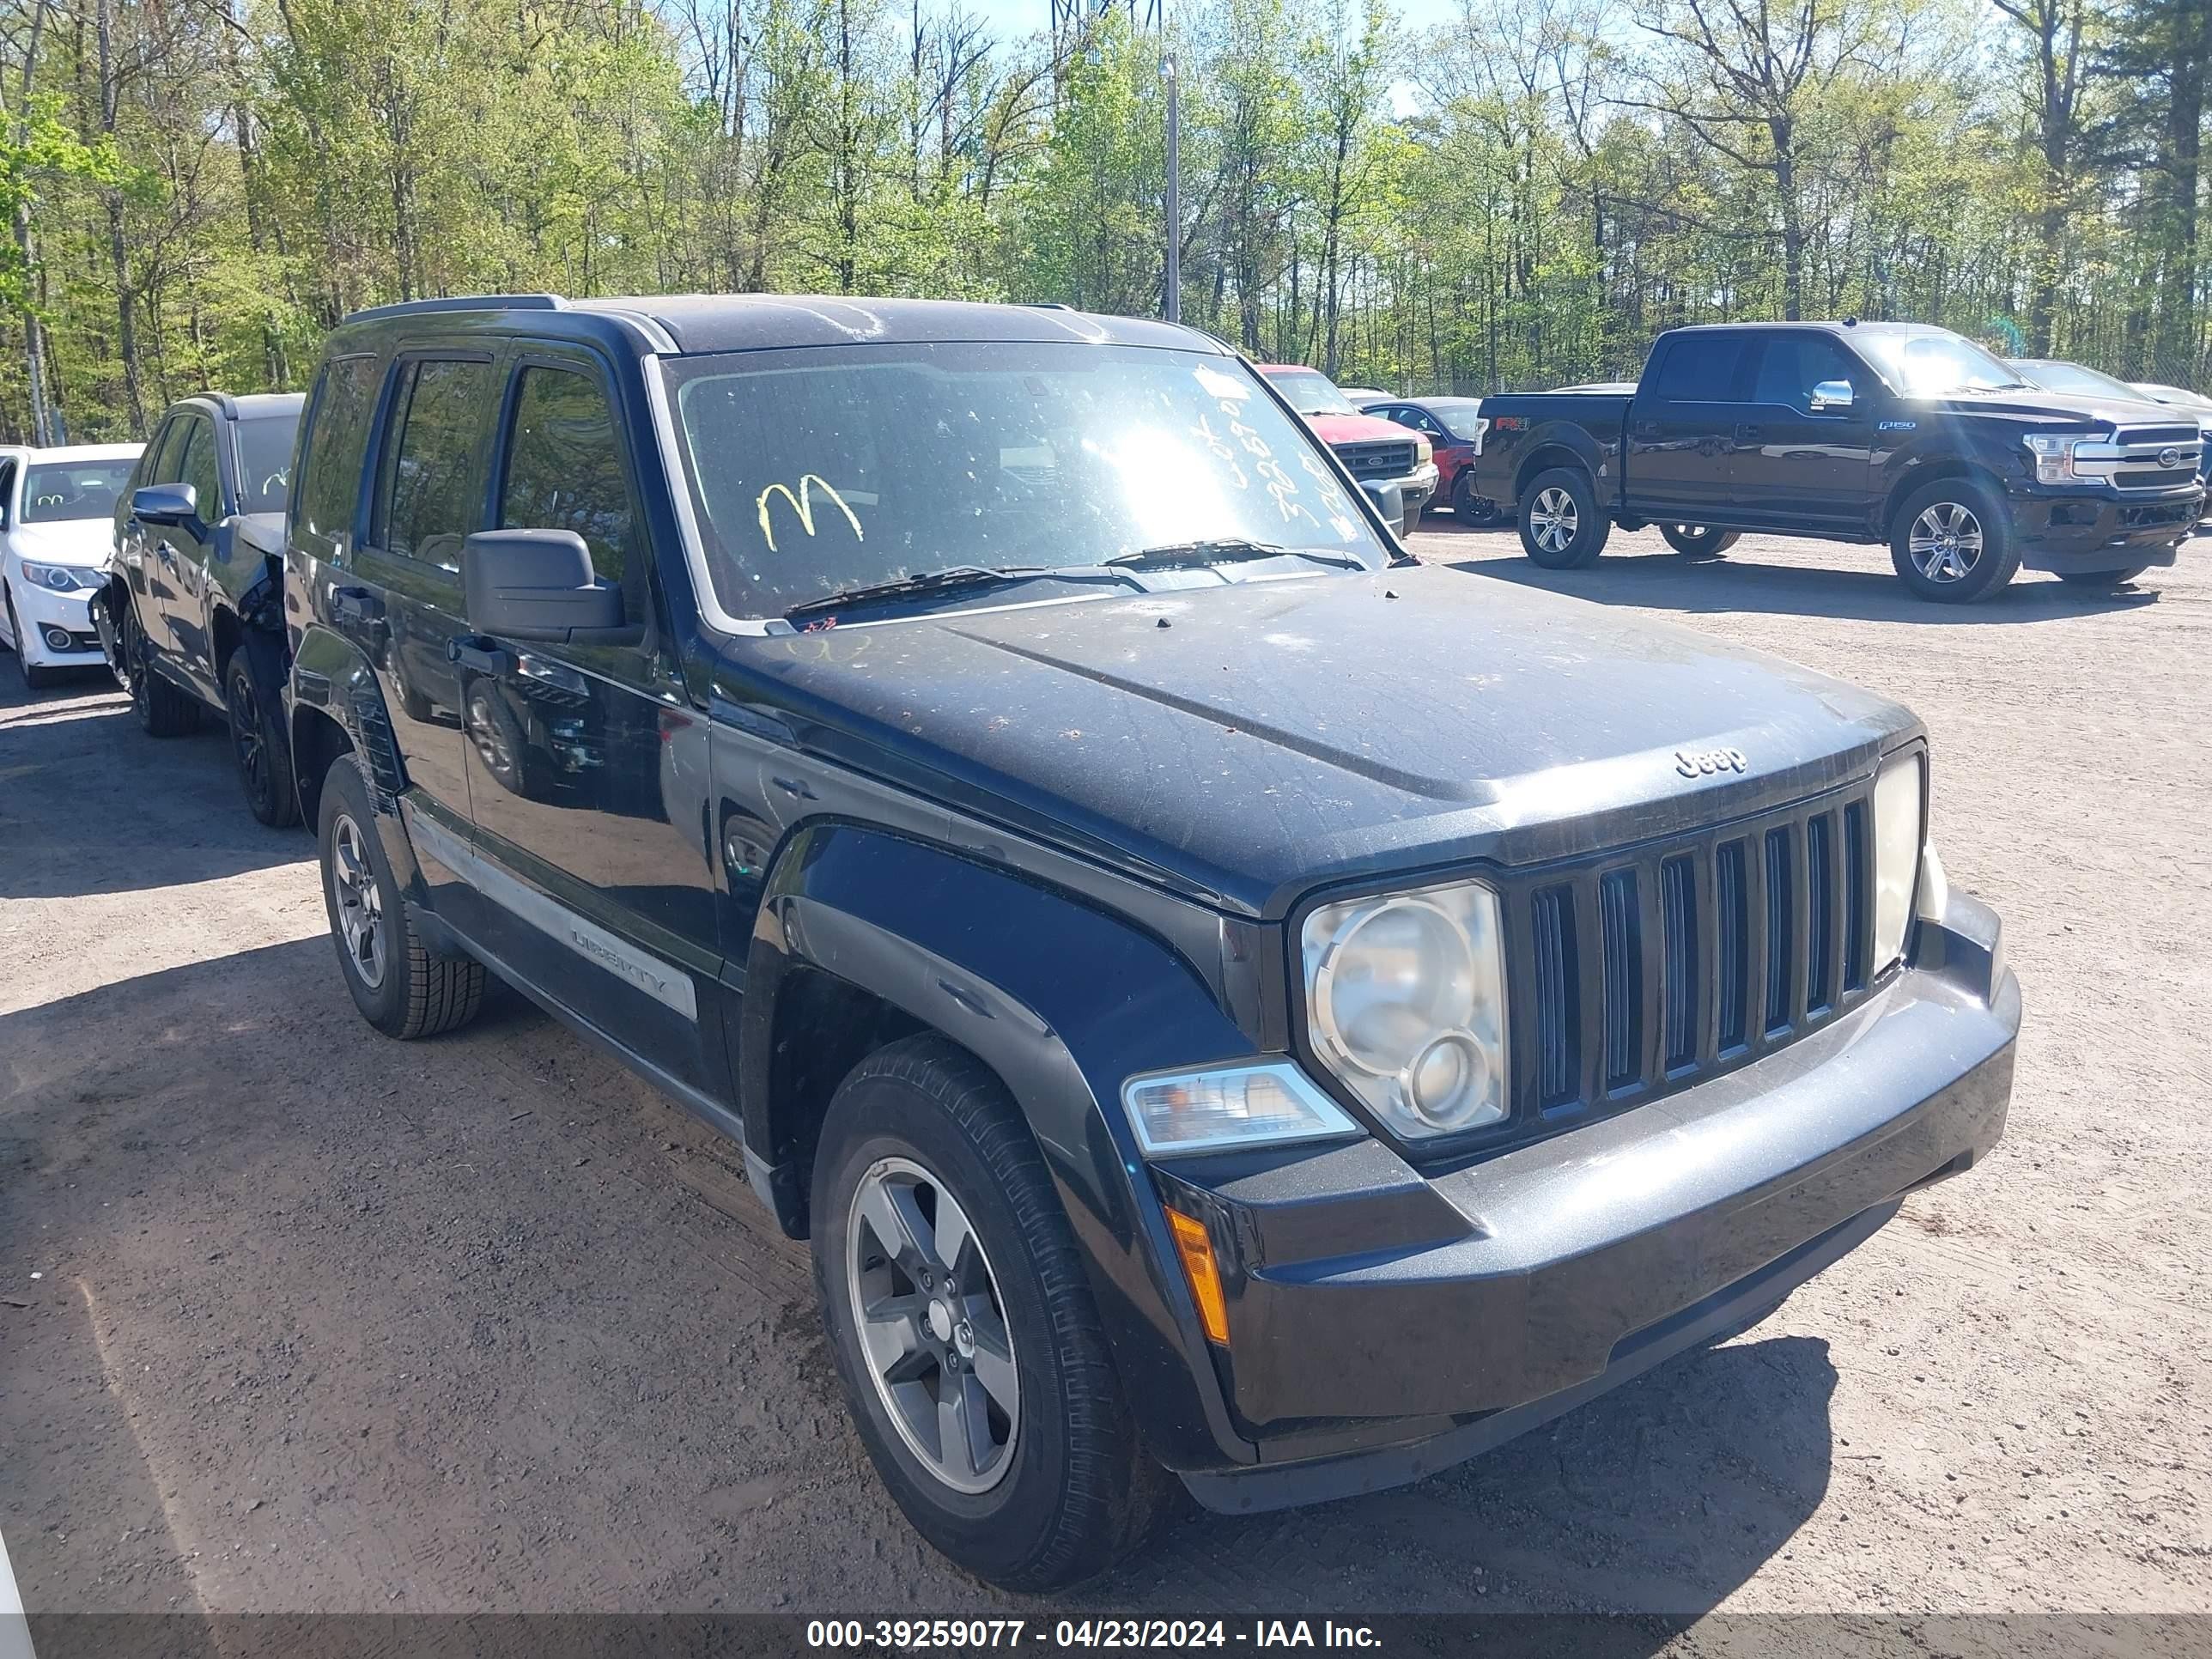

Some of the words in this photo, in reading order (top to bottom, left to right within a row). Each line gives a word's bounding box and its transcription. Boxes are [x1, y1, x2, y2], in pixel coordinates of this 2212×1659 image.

[1496, 417, 1530, 431] FX4
[1674, 746, 1748, 779] Jeep
[570, 928, 667, 993] LIBERTY
